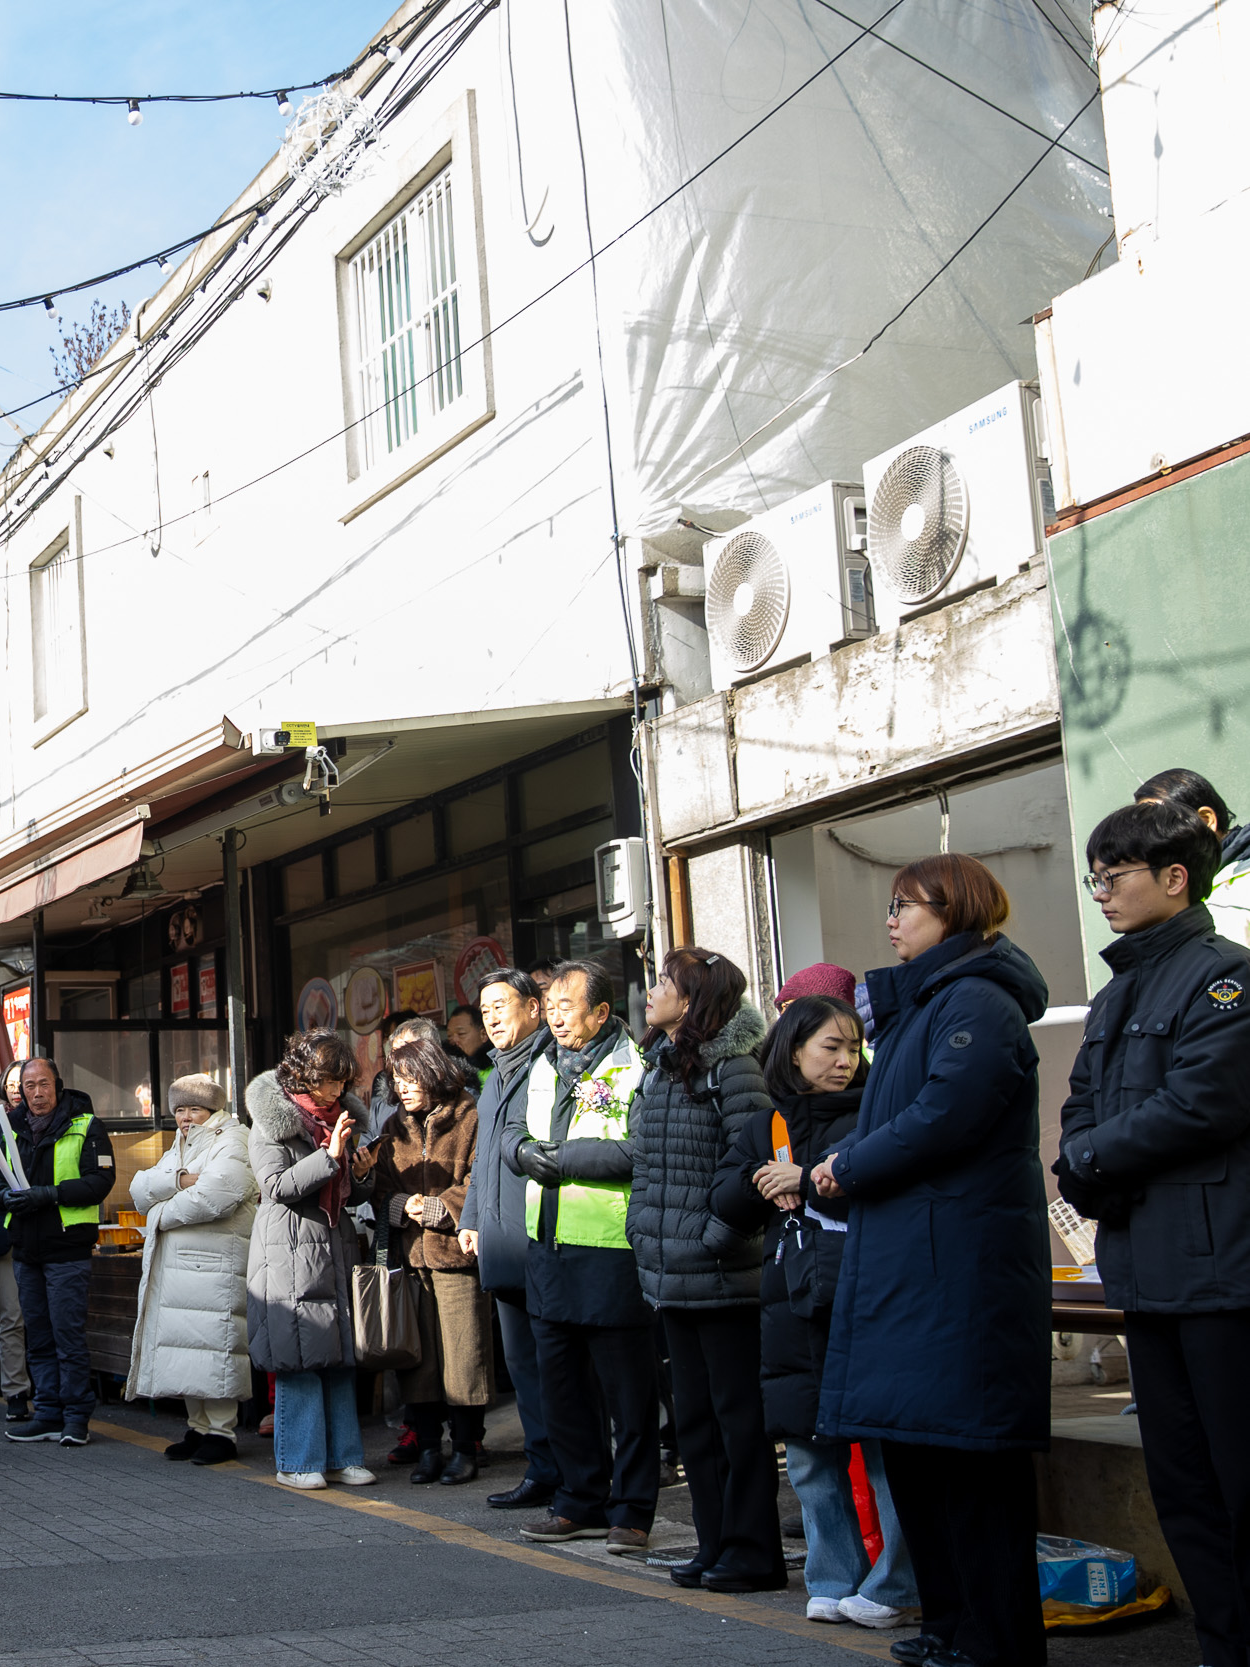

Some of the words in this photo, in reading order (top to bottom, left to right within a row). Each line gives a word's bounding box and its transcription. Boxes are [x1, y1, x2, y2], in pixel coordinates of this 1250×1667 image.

[968, 406, 1008, 435] SAMSUNG
[790, 503, 822, 526] SAMSUNG
[1089, 1568, 1099, 1596] DUTY
[1097, 1568, 1107, 1596] FREE
